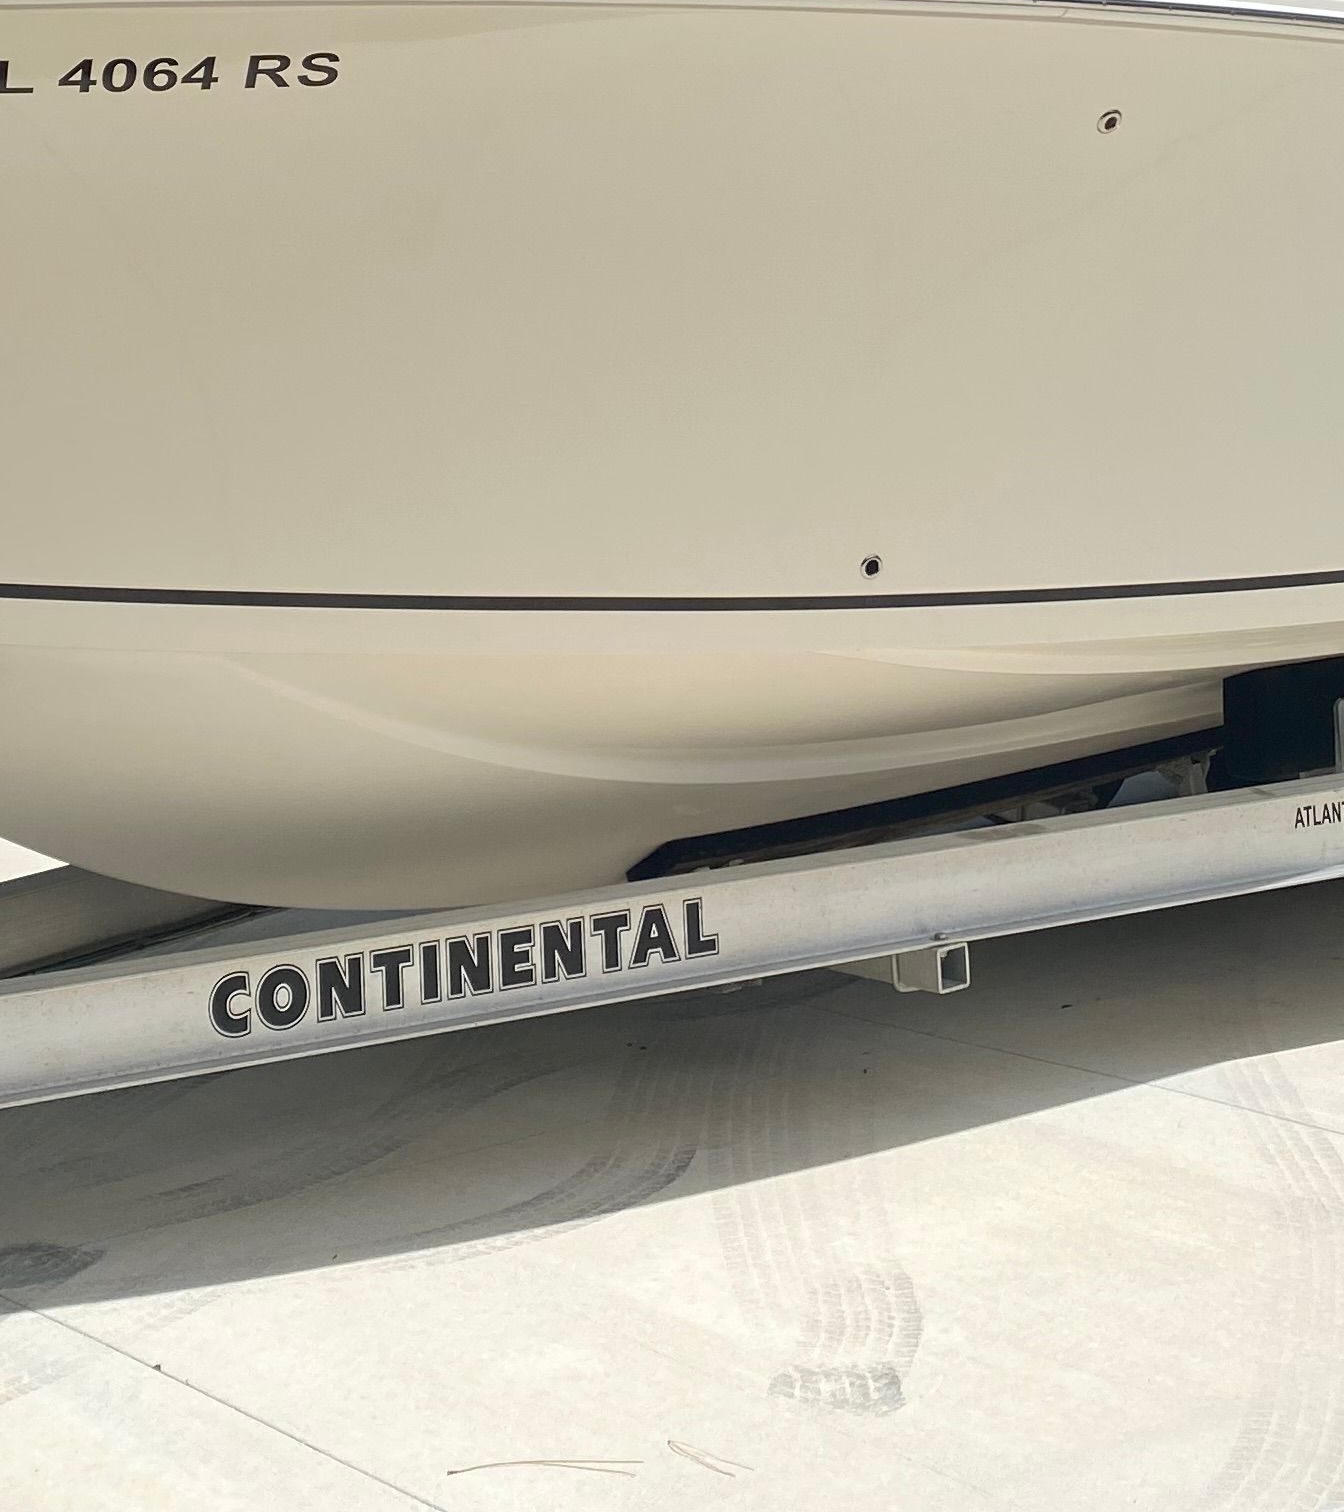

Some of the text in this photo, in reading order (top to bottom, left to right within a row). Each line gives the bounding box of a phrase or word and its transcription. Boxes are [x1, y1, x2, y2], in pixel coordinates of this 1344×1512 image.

[58, 56, 219, 93] 4064
[244, 52, 340, 88] RS
[208, 897, 719, 1038] CONTINENTAL
